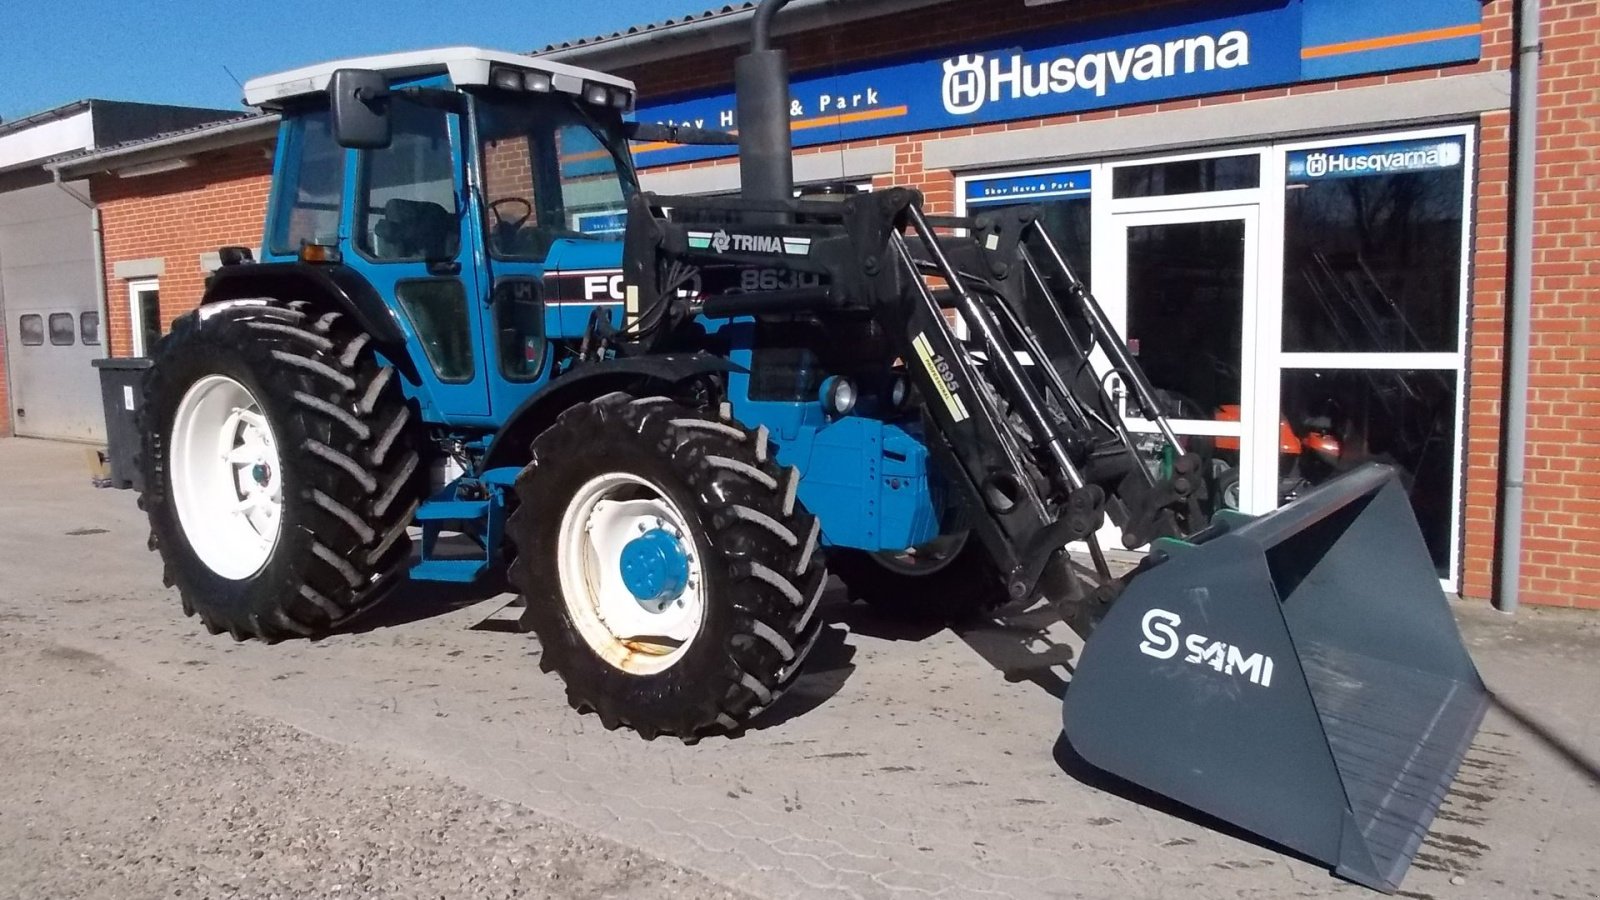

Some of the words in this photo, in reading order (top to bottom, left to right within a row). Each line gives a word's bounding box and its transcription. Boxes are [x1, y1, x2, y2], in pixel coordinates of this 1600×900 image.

[989, 30, 1250, 102] Husqvarna
[790, 100, 803, 116] &
[820, 88, 878, 112] Park
[1328, 149, 1438, 171] Husqvarna
[1012, 185, 1036, 193] Have
[1051, 181, 1075, 189] Park
[731, 234, 783, 253] TRIMA
[925, 359, 950, 400] PROFESSIONAL
[934, 355, 960, 391] 1695
[1184, 633, 1274, 687] SAMI
